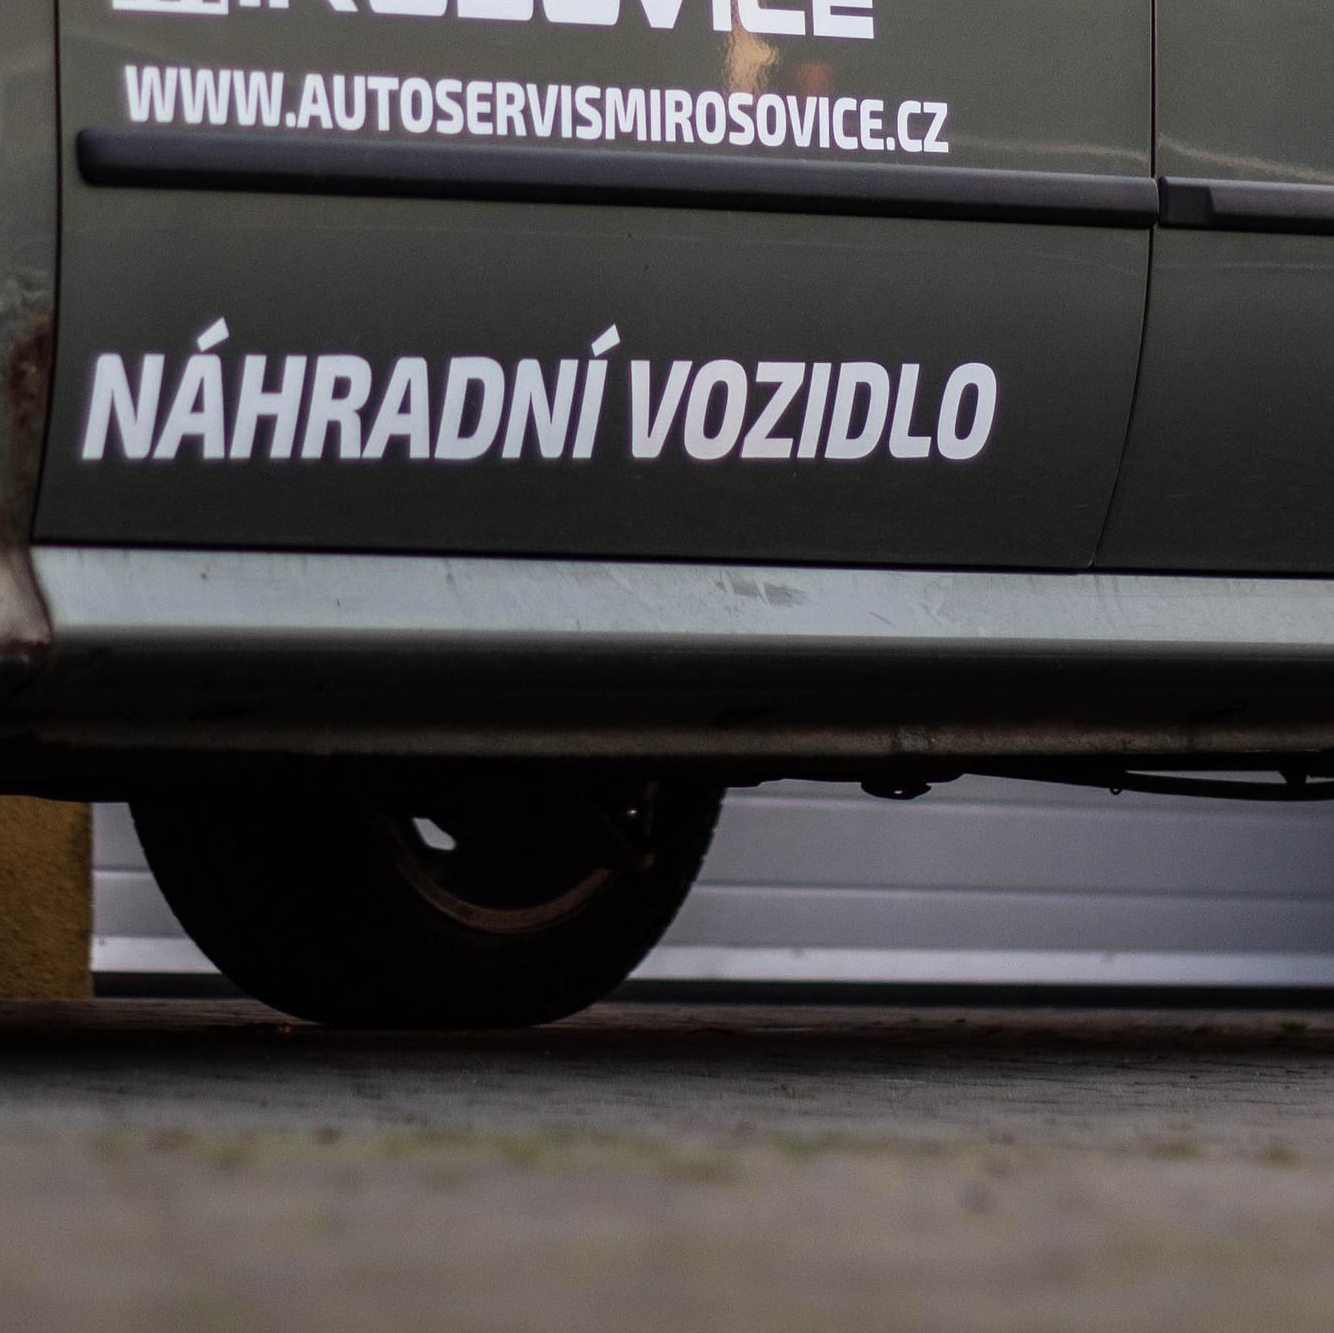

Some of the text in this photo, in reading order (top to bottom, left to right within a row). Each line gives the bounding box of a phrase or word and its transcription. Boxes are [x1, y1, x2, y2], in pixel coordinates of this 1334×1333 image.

[123, 65, 950, 155] WWW.AUTOSERVISMIROSOVICE.CZ
[82, 317, 999, 461] NÁHRADNÍ VOZIDLO
